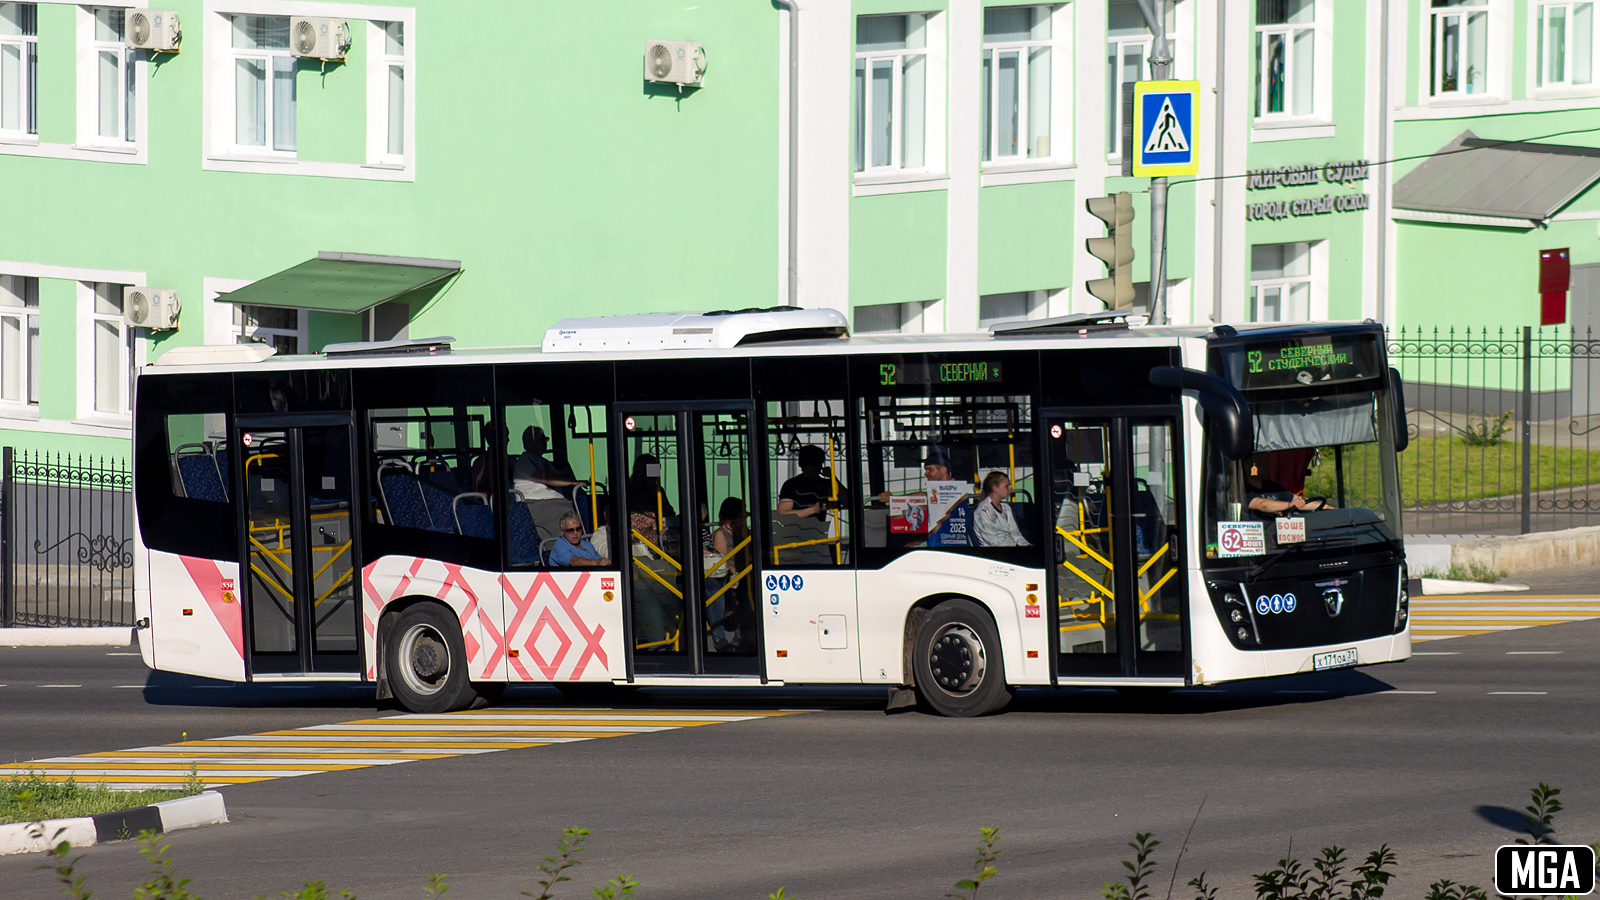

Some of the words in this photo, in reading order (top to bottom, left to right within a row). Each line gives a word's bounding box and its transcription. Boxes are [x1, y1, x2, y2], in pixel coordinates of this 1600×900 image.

[1247, 165, 1319, 189] МИРОВЫЕ
[1247, 201, 1289, 220] ГОРОДА
[1289, 195, 1333, 217] СТАРЫЙ
[1333, 194, 1369, 213] ОСКОЛ
[1280, 344, 1333, 359] СЕВЕРНЫЙ
[1247, 350, 1263, 374] 52
[1268, 353, 1347, 371] СТУДЕНЧЕСКИЙ
[880, 364, 896, 385] 52
[940, 361, 988, 381] СЕВЕРНЫЙ
[958, 507, 965, 517] 14
[950, 523, 966, 533] 2025
[1277, 522, 1304, 530] БОШЕ
[1224, 532, 1241, 549] 52
[1278, 534, 1304, 542] КОСМОС
[1348, 650, 1355, 659] 31
